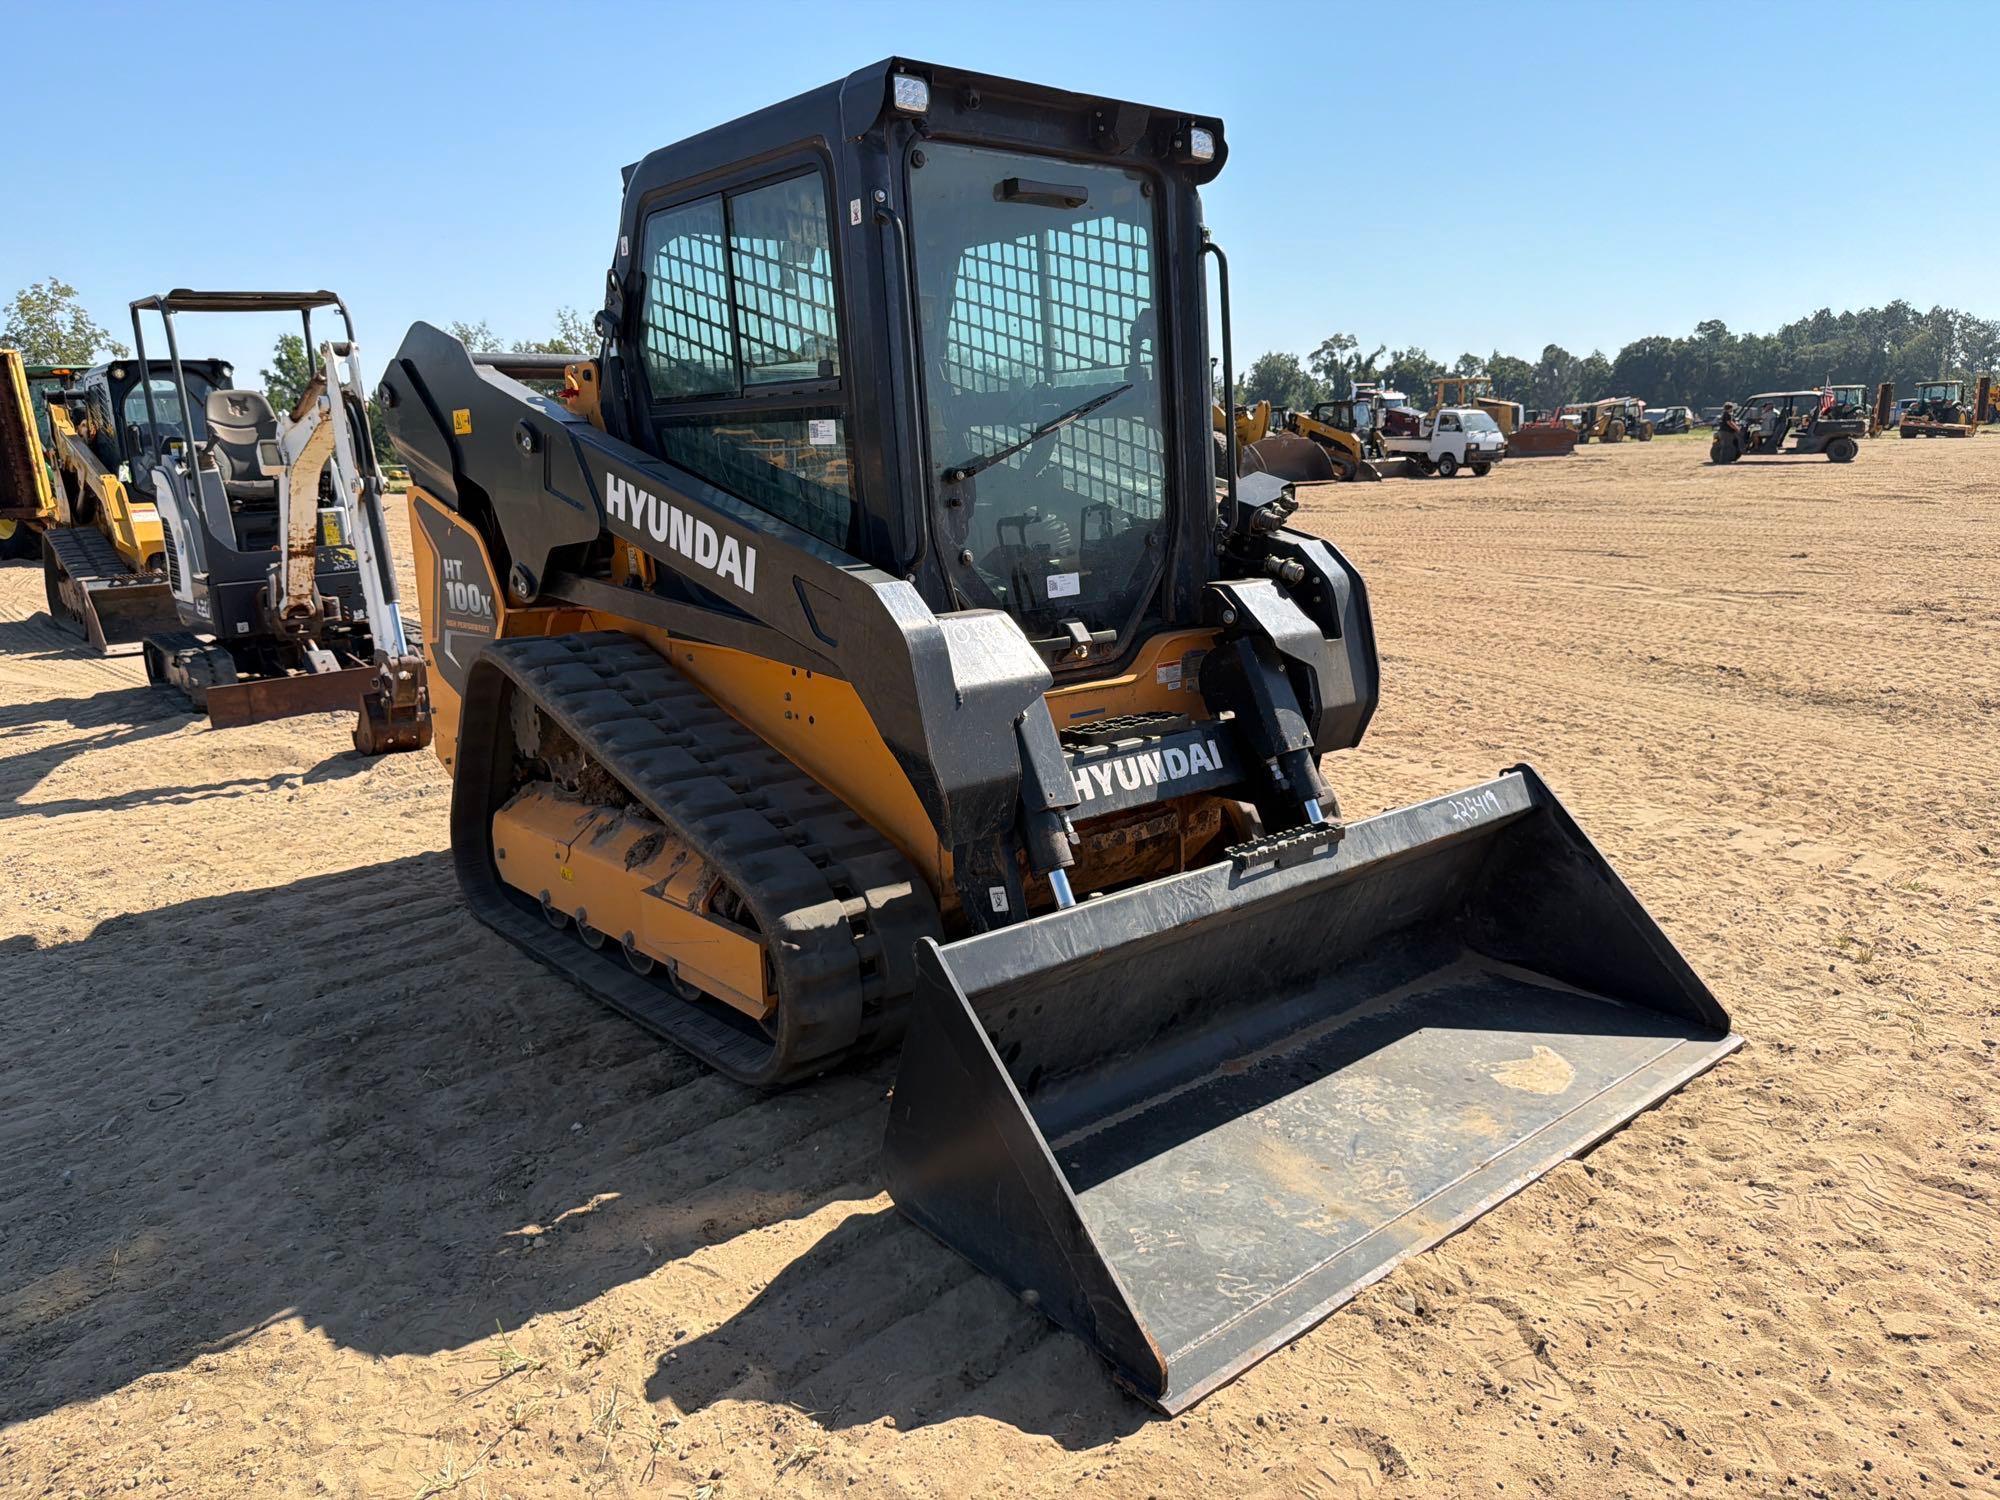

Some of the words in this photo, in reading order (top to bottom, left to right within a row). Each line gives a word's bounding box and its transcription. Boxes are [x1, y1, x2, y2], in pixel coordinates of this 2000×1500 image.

[606, 472, 756, 595] HYUNDAI
[443, 559, 462, 580] HT
[1070, 739, 1223, 801] HYUNDAI
